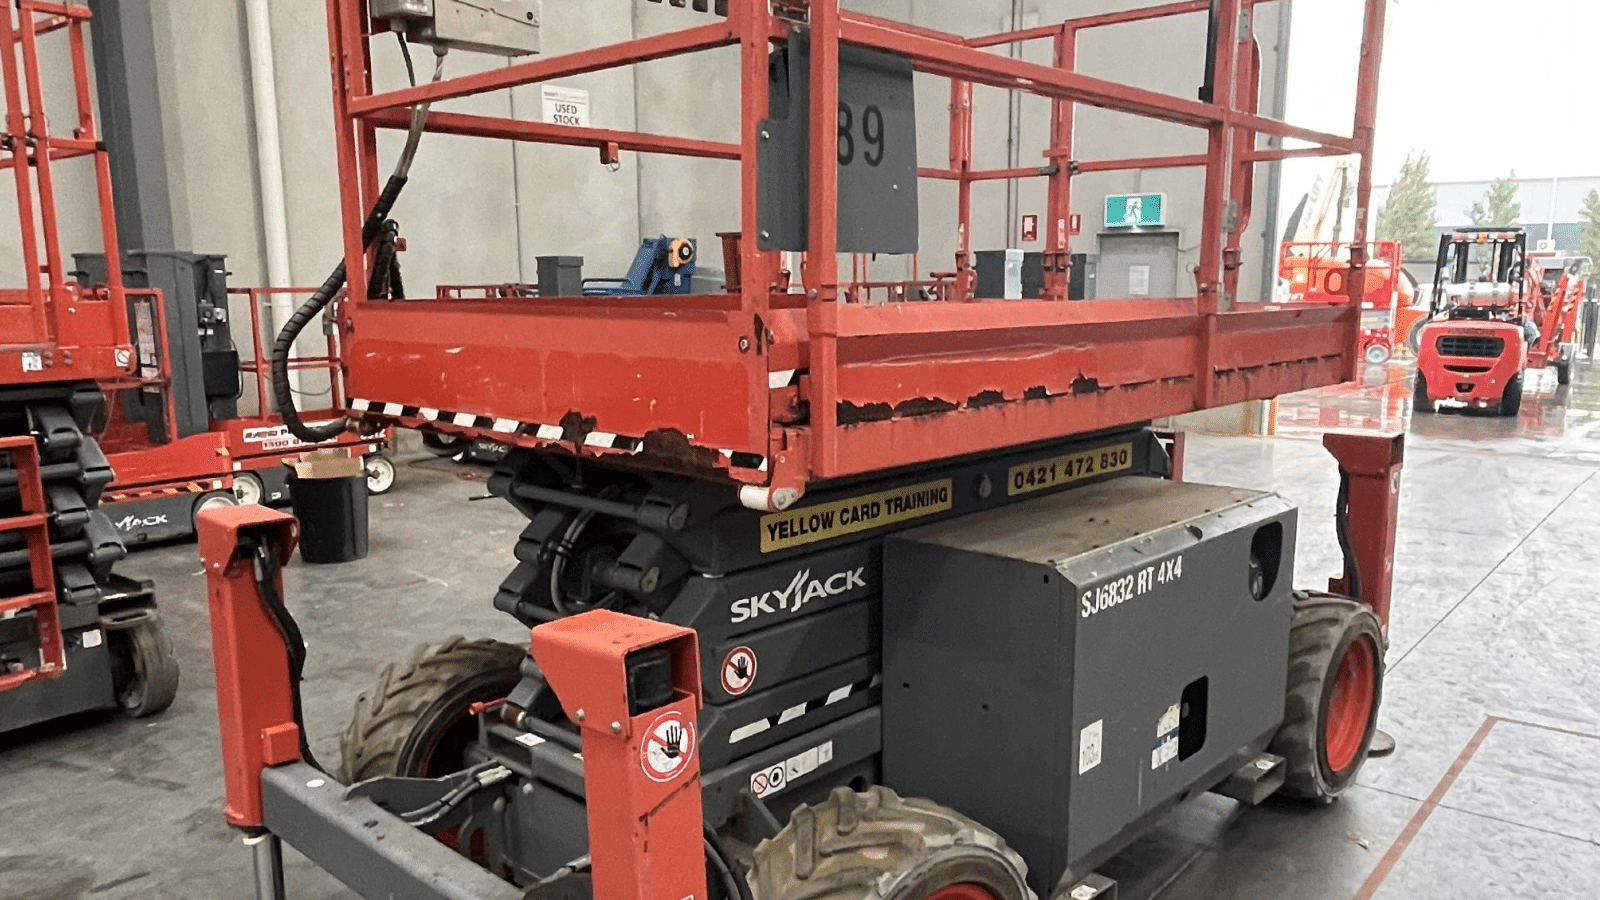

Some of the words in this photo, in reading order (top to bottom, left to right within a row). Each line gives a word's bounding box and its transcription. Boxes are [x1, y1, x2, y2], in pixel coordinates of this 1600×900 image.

[553, 114, 580, 125] STOCK
[554, 103, 577, 114] USED
[1014, 464, 1056, 489] 0421
[1064, 456, 1094, 477] 472
[1100, 449, 1127, 469] 830
[767, 510, 835, 541] YELLOW
[840, 501, 881, 526] CARD
[885, 487, 948, 516] TRAINING
[730, 567, 866, 623] SKYJACK
[1081, 574, 1134, 618] SJ6832
[1137, 566, 1155, 595] RT
[1157, 555, 1182, 584] 4X4
